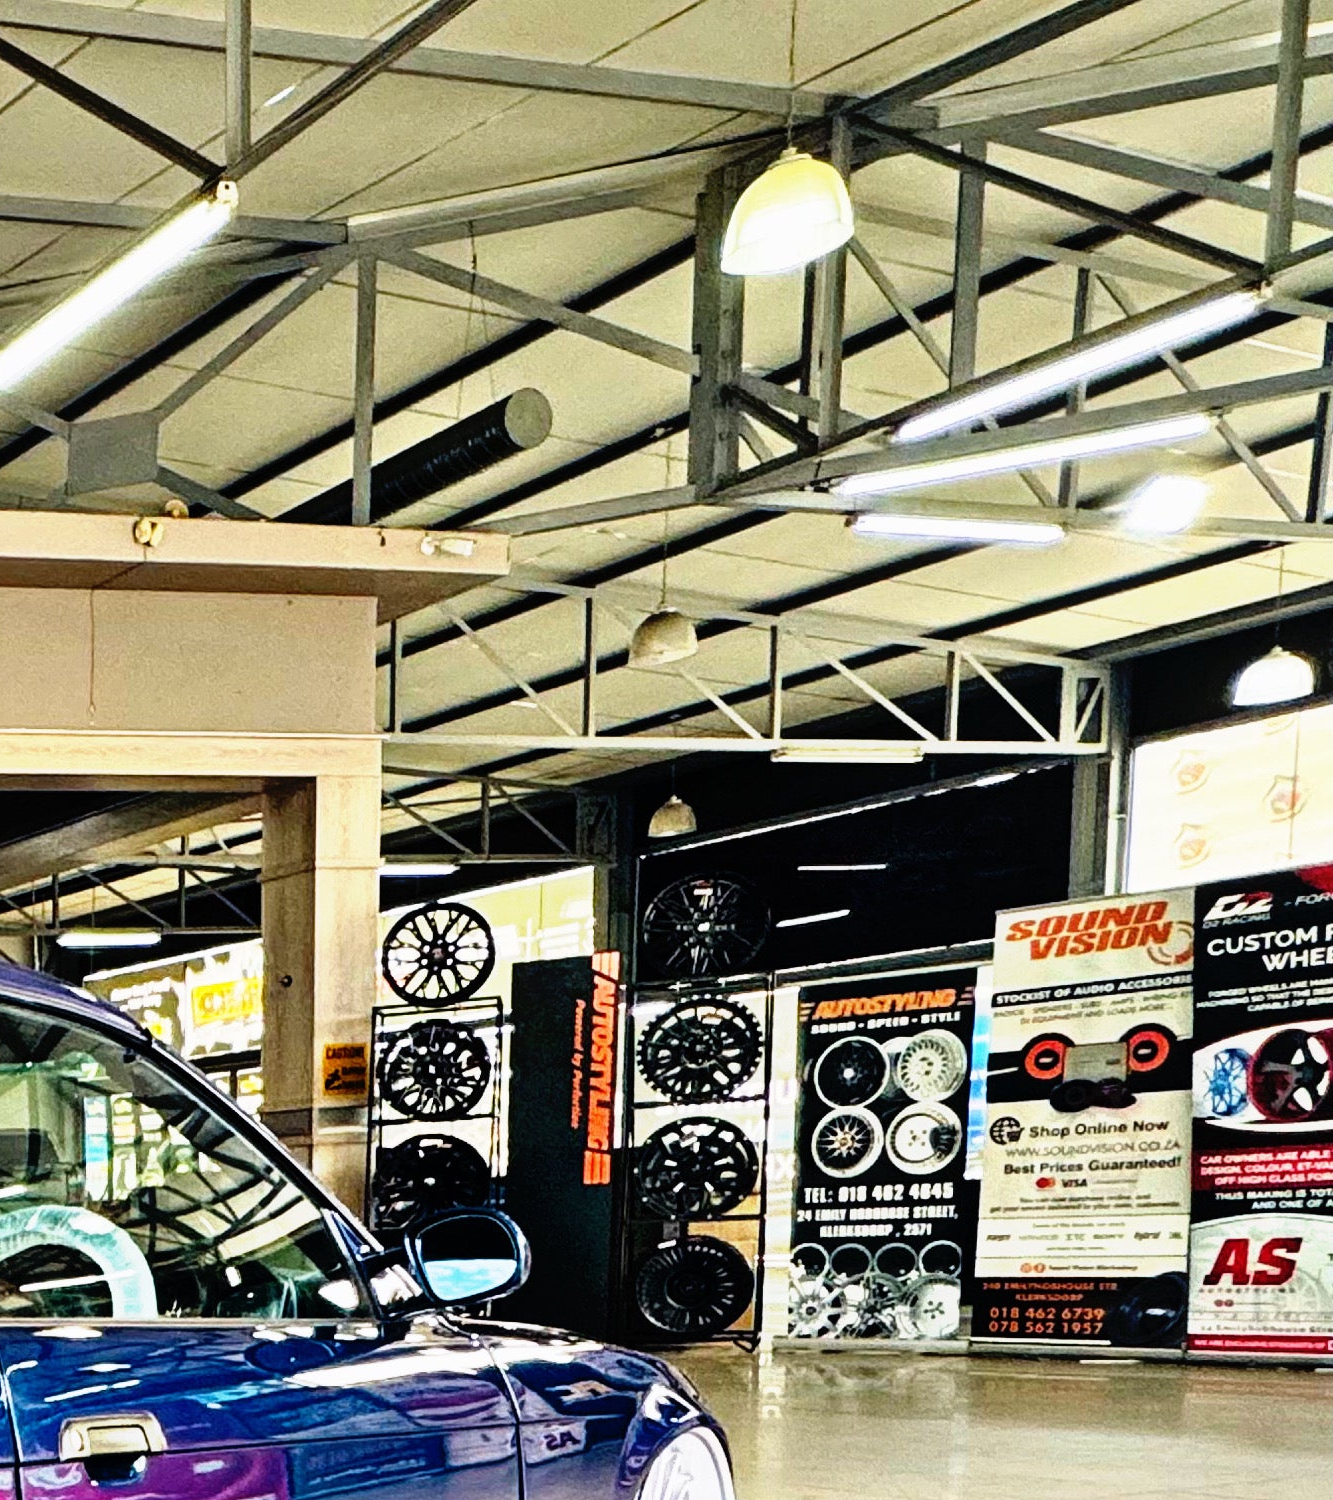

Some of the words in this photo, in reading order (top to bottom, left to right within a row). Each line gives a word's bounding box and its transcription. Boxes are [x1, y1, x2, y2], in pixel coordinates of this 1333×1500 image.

[1294, 891, 1333, 907] FOR
[1006, 900, 1169, 942] SOUND
[1029, 921, 1173, 961] VISION
[1206, 925, 1319, 957] CUSTOM
[996, 989, 1052, 1005] STOCKIST
[1053, 988, 1073, 998] OF
[1073, 983, 1115, 997] AUDIO
[811, 988, 958, 1020] AUTOSTYLING
[920, 1011, 961, 1025] STYLE
[587, 974, 617, 1151] AUTOSTYLING
[1029, 1124, 1071, 1139] Shop
[1074, 1121, 1128, 1136] Online
[1132, 1119, 1170, 1132] Now
[1003, 1163, 1035, 1175] Best
[1039, 1162, 1084, 1173] Prices
[1087, 1156, 1183, 1172] Guaranteed!
[1200, 1155, 1223, 1165] CAR
[1275, 1151, 1299, 1161] ARE
[1300, 1149, 1331, 1160] ABLE
[1061, 1178, 1088, 1189] VISA
[1214, 1176, 1236, 1186] OFF
[1268, 1173, 1306, 1184] CLASS
[803, 1187, 834, 1204] TEL:
[1251, 1200, 1277, 1210] AND
[1278, 1199, 1304, 1209] ONE
[1306, 1199, 1324, 1208] OF
[796, 1209, 813, 1223] 24
[1202, 1236, 1304, 1286] AS
[989, 1307, 1020, 1319] 018
[1025, 1307, 1057, 1320] 462
[1061, 1307, 1106, 1321] 6739
[988, 1321, 1020, 1333] 078
[1025, 1321, 1056, 1334] 562
[1062, 1322, 1105, 1335] 1957
